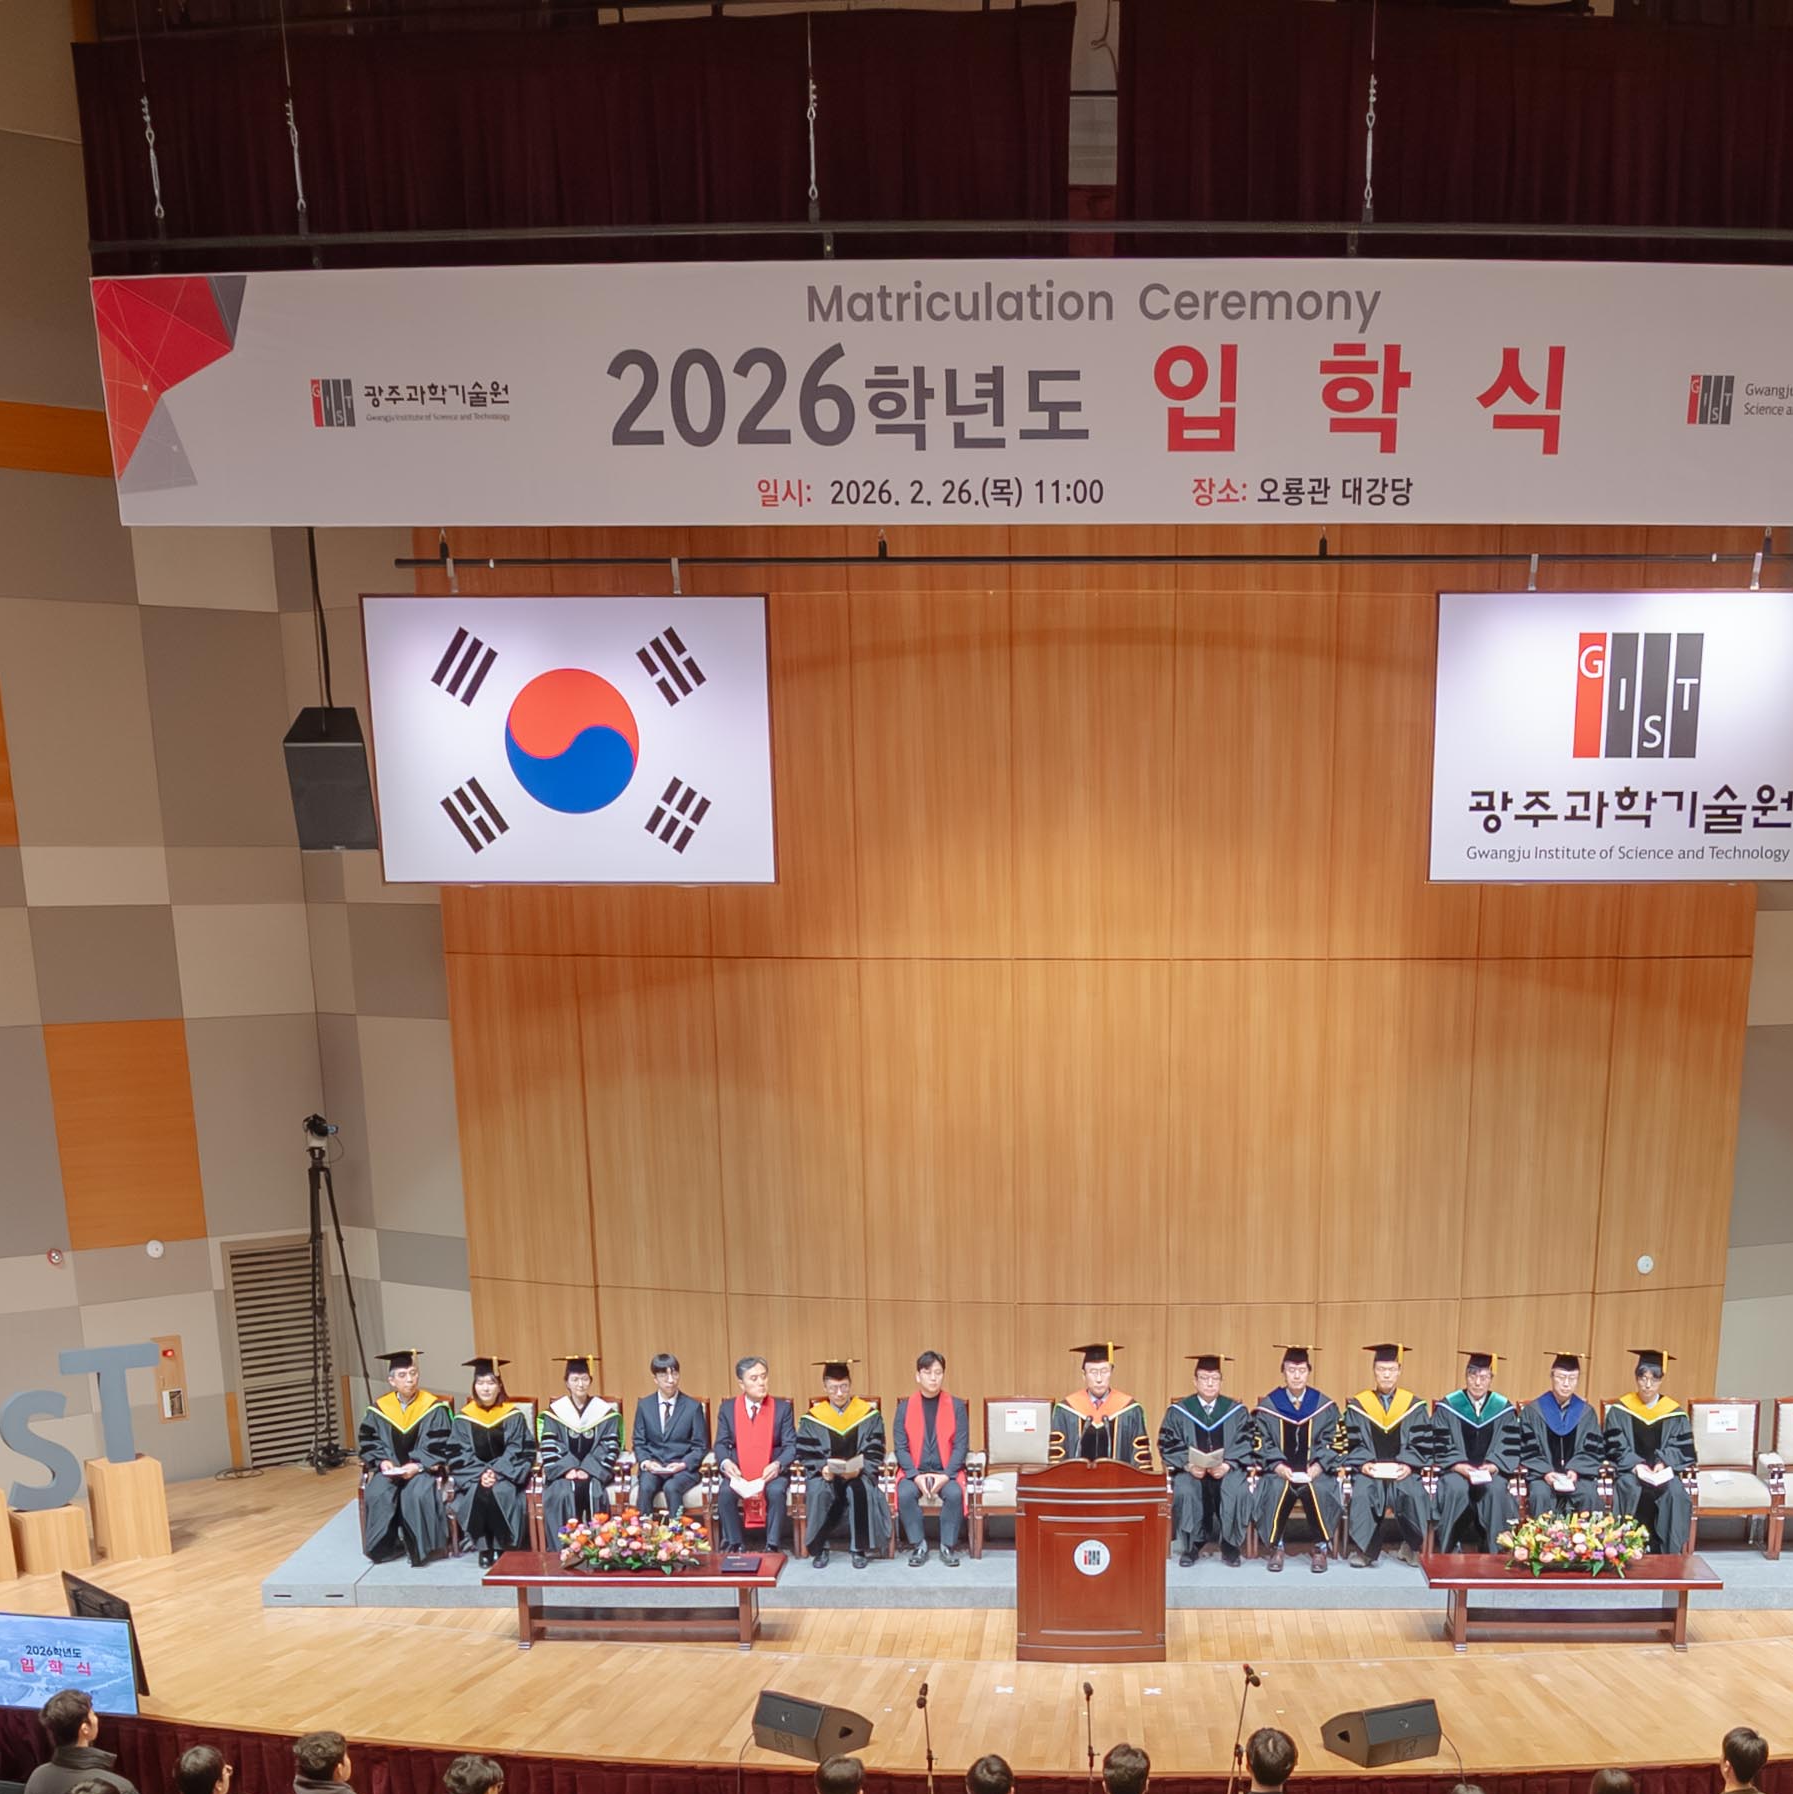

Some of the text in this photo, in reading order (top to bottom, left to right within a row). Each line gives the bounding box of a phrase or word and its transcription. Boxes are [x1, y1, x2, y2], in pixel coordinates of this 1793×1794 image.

[806, 280, 1381, 334] Matriculation Ceremony
[364, 381, 510, 408] 광주과학기술원
[606, 341, 1090, 451] 2026학년도
[1743, 402, 1783, 417] Science
[757, 477, 1105, 508] 일시: 2026. 2. 26.(목) 11:00
[1192, 477, 1413, 507] 장소: 오룡관 대강당
[1576, 636, 1703, 755] GIST
[1466, 846, 1791, 863] Gwangju Institute of Science and Technology
[25, 1645, 82, 1658] 2026학년도
